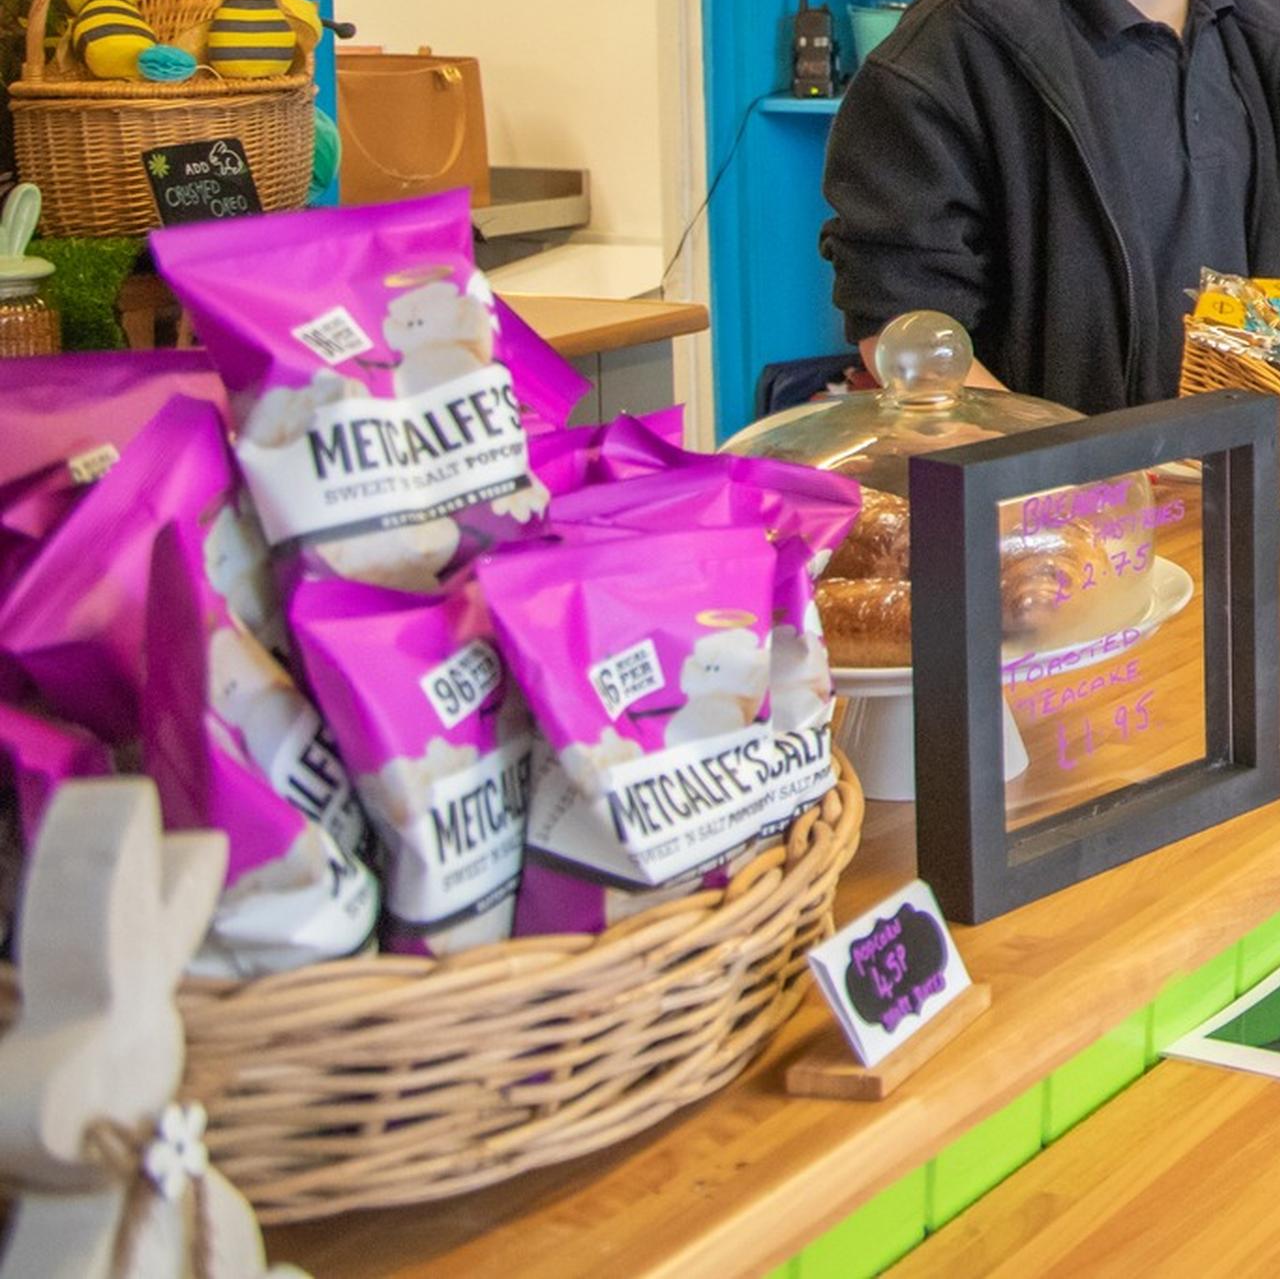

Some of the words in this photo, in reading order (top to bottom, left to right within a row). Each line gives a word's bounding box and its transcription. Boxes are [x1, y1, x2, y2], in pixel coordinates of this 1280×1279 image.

[185, 161, 210, 175] ADD
[210, 194, 248, 218] OREO
[306, 383, 523, 481] METCALFE'S
[1001, 625, 1142, 693] TOASTED
[1016, 659, 1141, 720] TEACAKE
[433, 668, 477, 715] 96
[606, 738, 765, 846] METCALFE'S
